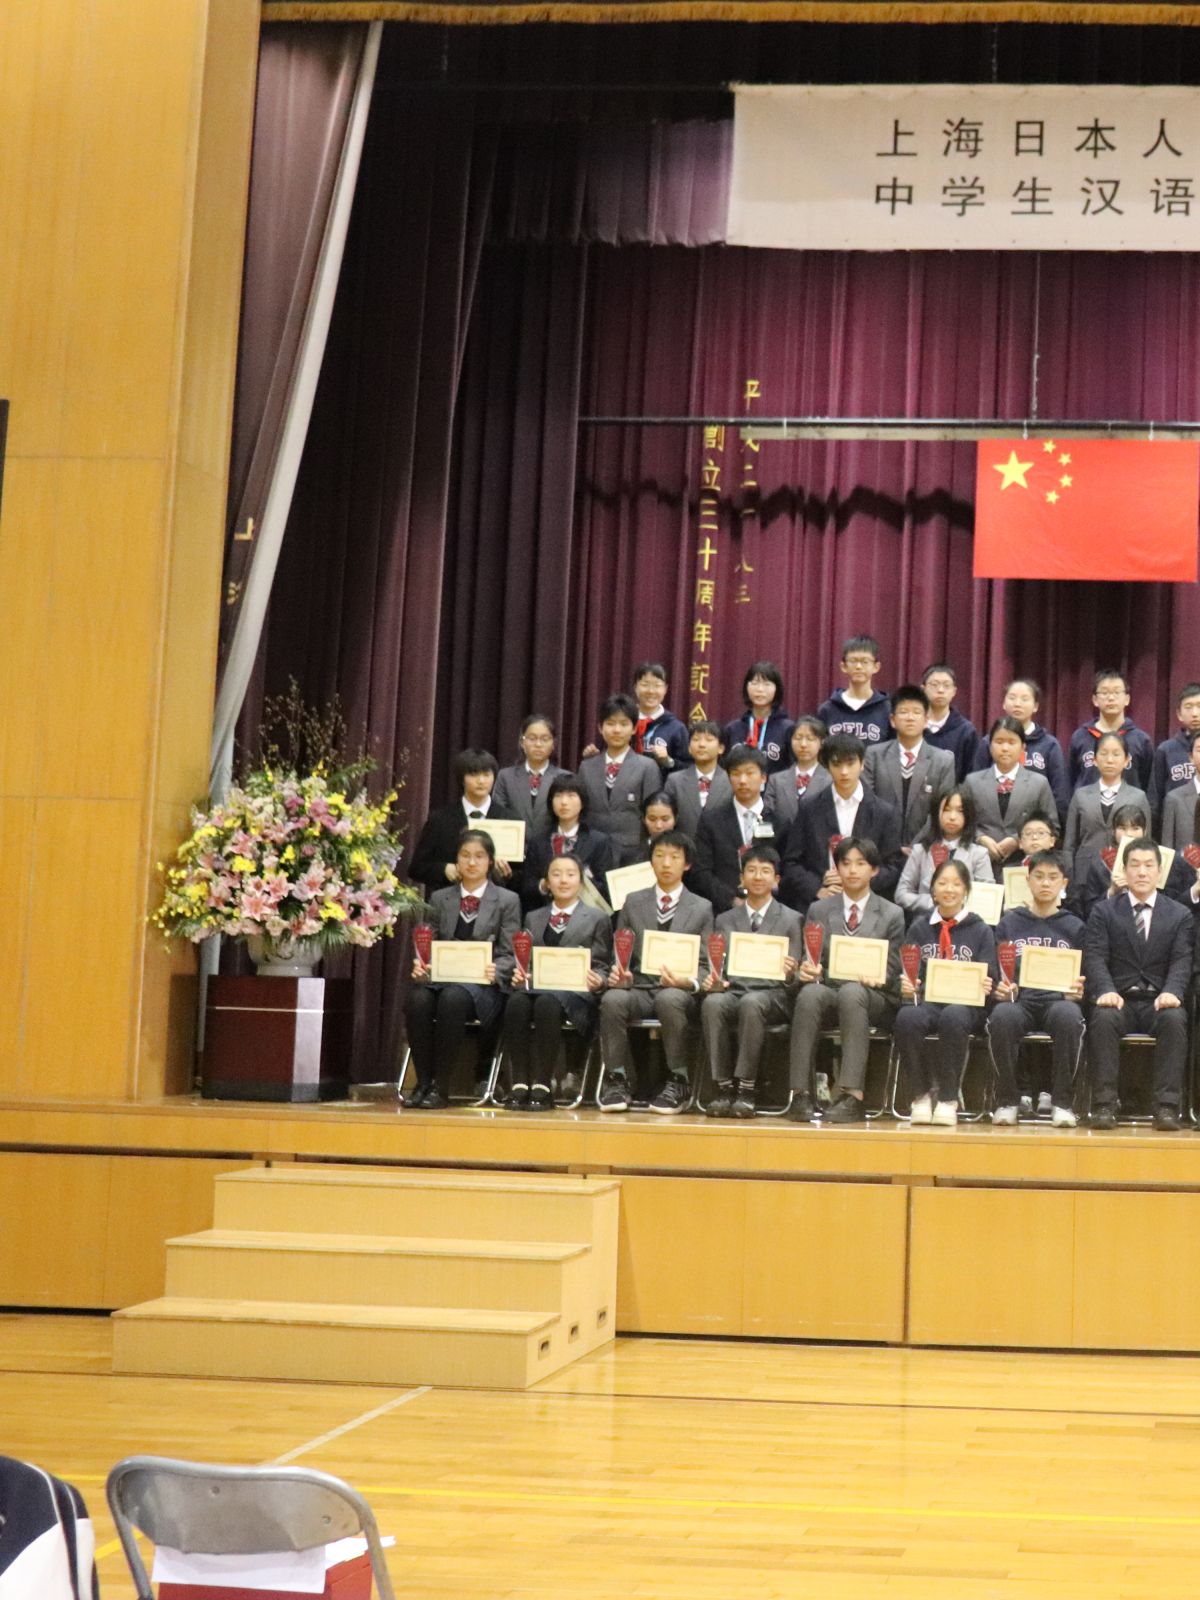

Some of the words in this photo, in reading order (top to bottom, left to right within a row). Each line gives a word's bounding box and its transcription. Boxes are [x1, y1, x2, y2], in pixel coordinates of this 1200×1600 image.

[874, 176, 1195, 217] 中学生汉语
